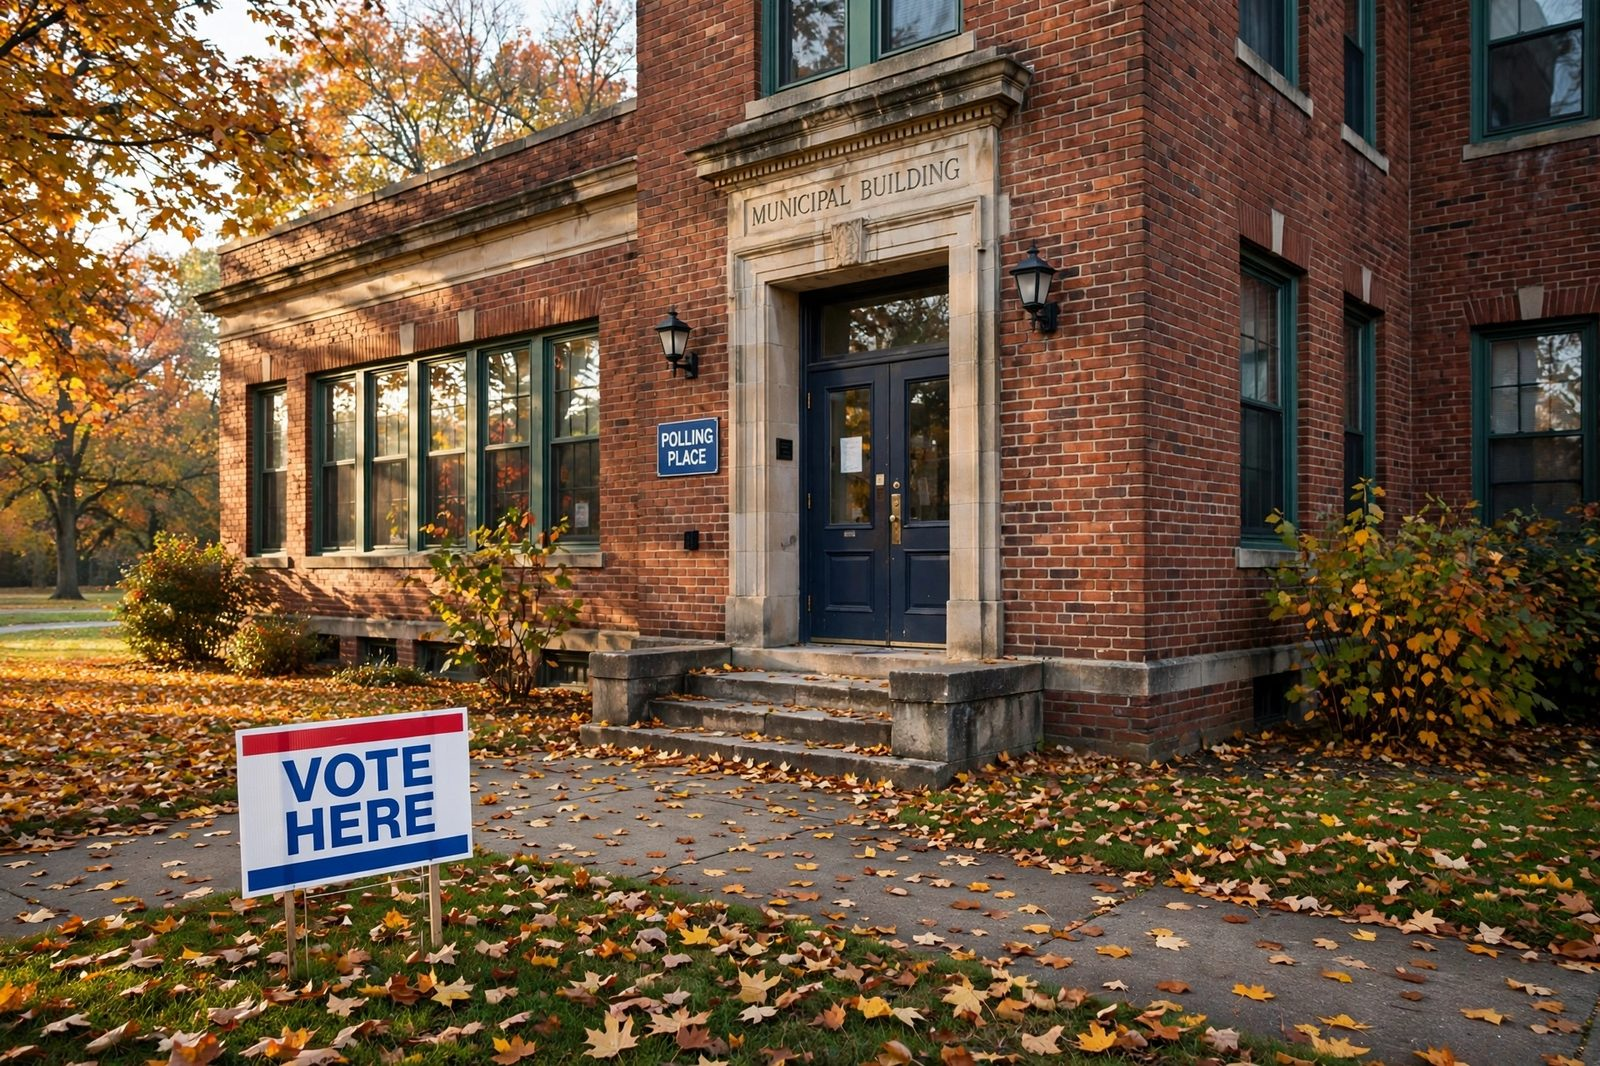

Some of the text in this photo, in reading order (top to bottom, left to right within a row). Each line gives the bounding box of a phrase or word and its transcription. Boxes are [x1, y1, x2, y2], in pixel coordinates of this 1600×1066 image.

[752, 157, 960, 227] MUNICIPAL BUILDING
[661, 427, 714, 448] POLLING
[668, 448, 707, 467] PLACE
[282, 743, 433, 802] VOTE
[286, 792, 436, 856] HERE
